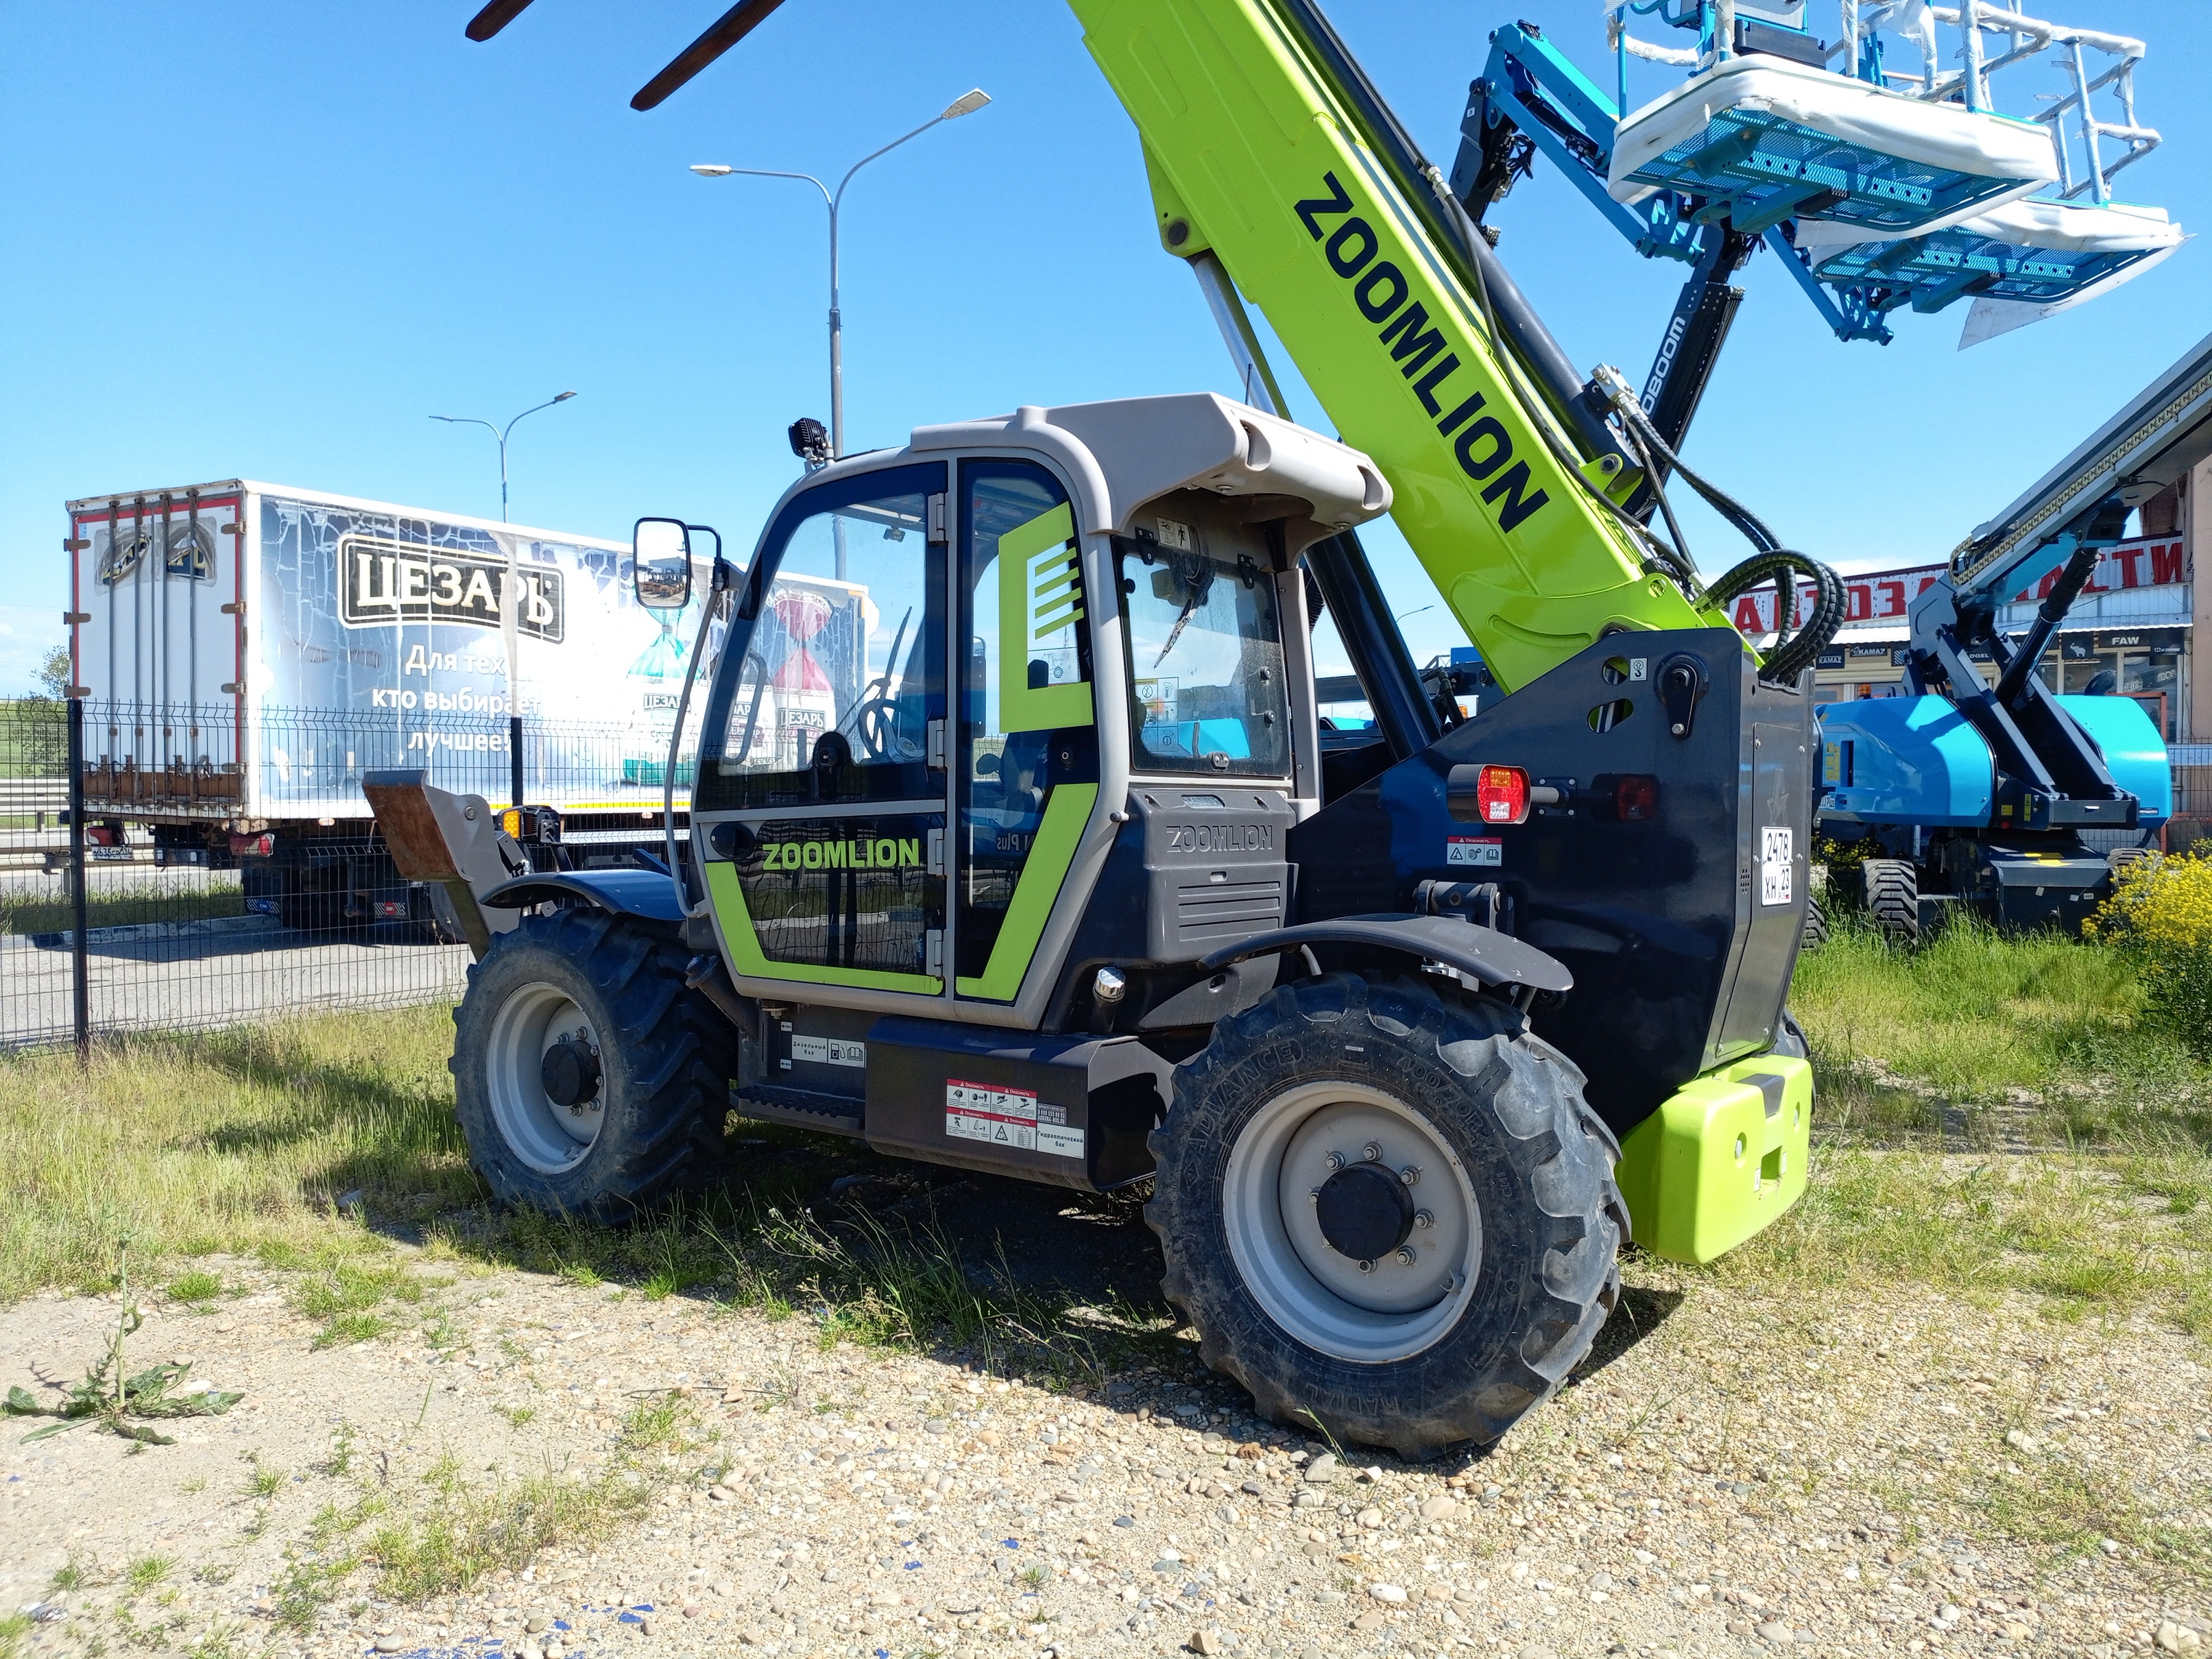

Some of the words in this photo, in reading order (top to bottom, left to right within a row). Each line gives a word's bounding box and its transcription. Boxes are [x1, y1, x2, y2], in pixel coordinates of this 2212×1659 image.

[1293, 170, 1550, 534] ZOOMLION
[1641, 316, 1686, 415] OBOOM
[2112, 636, 2139, 645] FAW
[405, 644, 457, 677] Для
[372, 688, 418, 710] кто
[1166, 825, 1273, 853] ZOOMLION
[1767, 832, 1788, 862] 2478
[762, 838, 919, 870] ZOOMLION
[1781, 868, 1790, 891] 23
[793, 1041, 826, 1050] Дизельный
[1009, 1088, 1031, 1097] Опасность
[1188, 1043, 1297, 1159] ADVANCE
[964, 1110, 985, 1118] Опасность
[1009, 1117, 1030, 1126] Опасность
[1397, 1056, 1504, 1162] 400/70R24
[1037, 1130, 1083, 1143] Гидравлический
